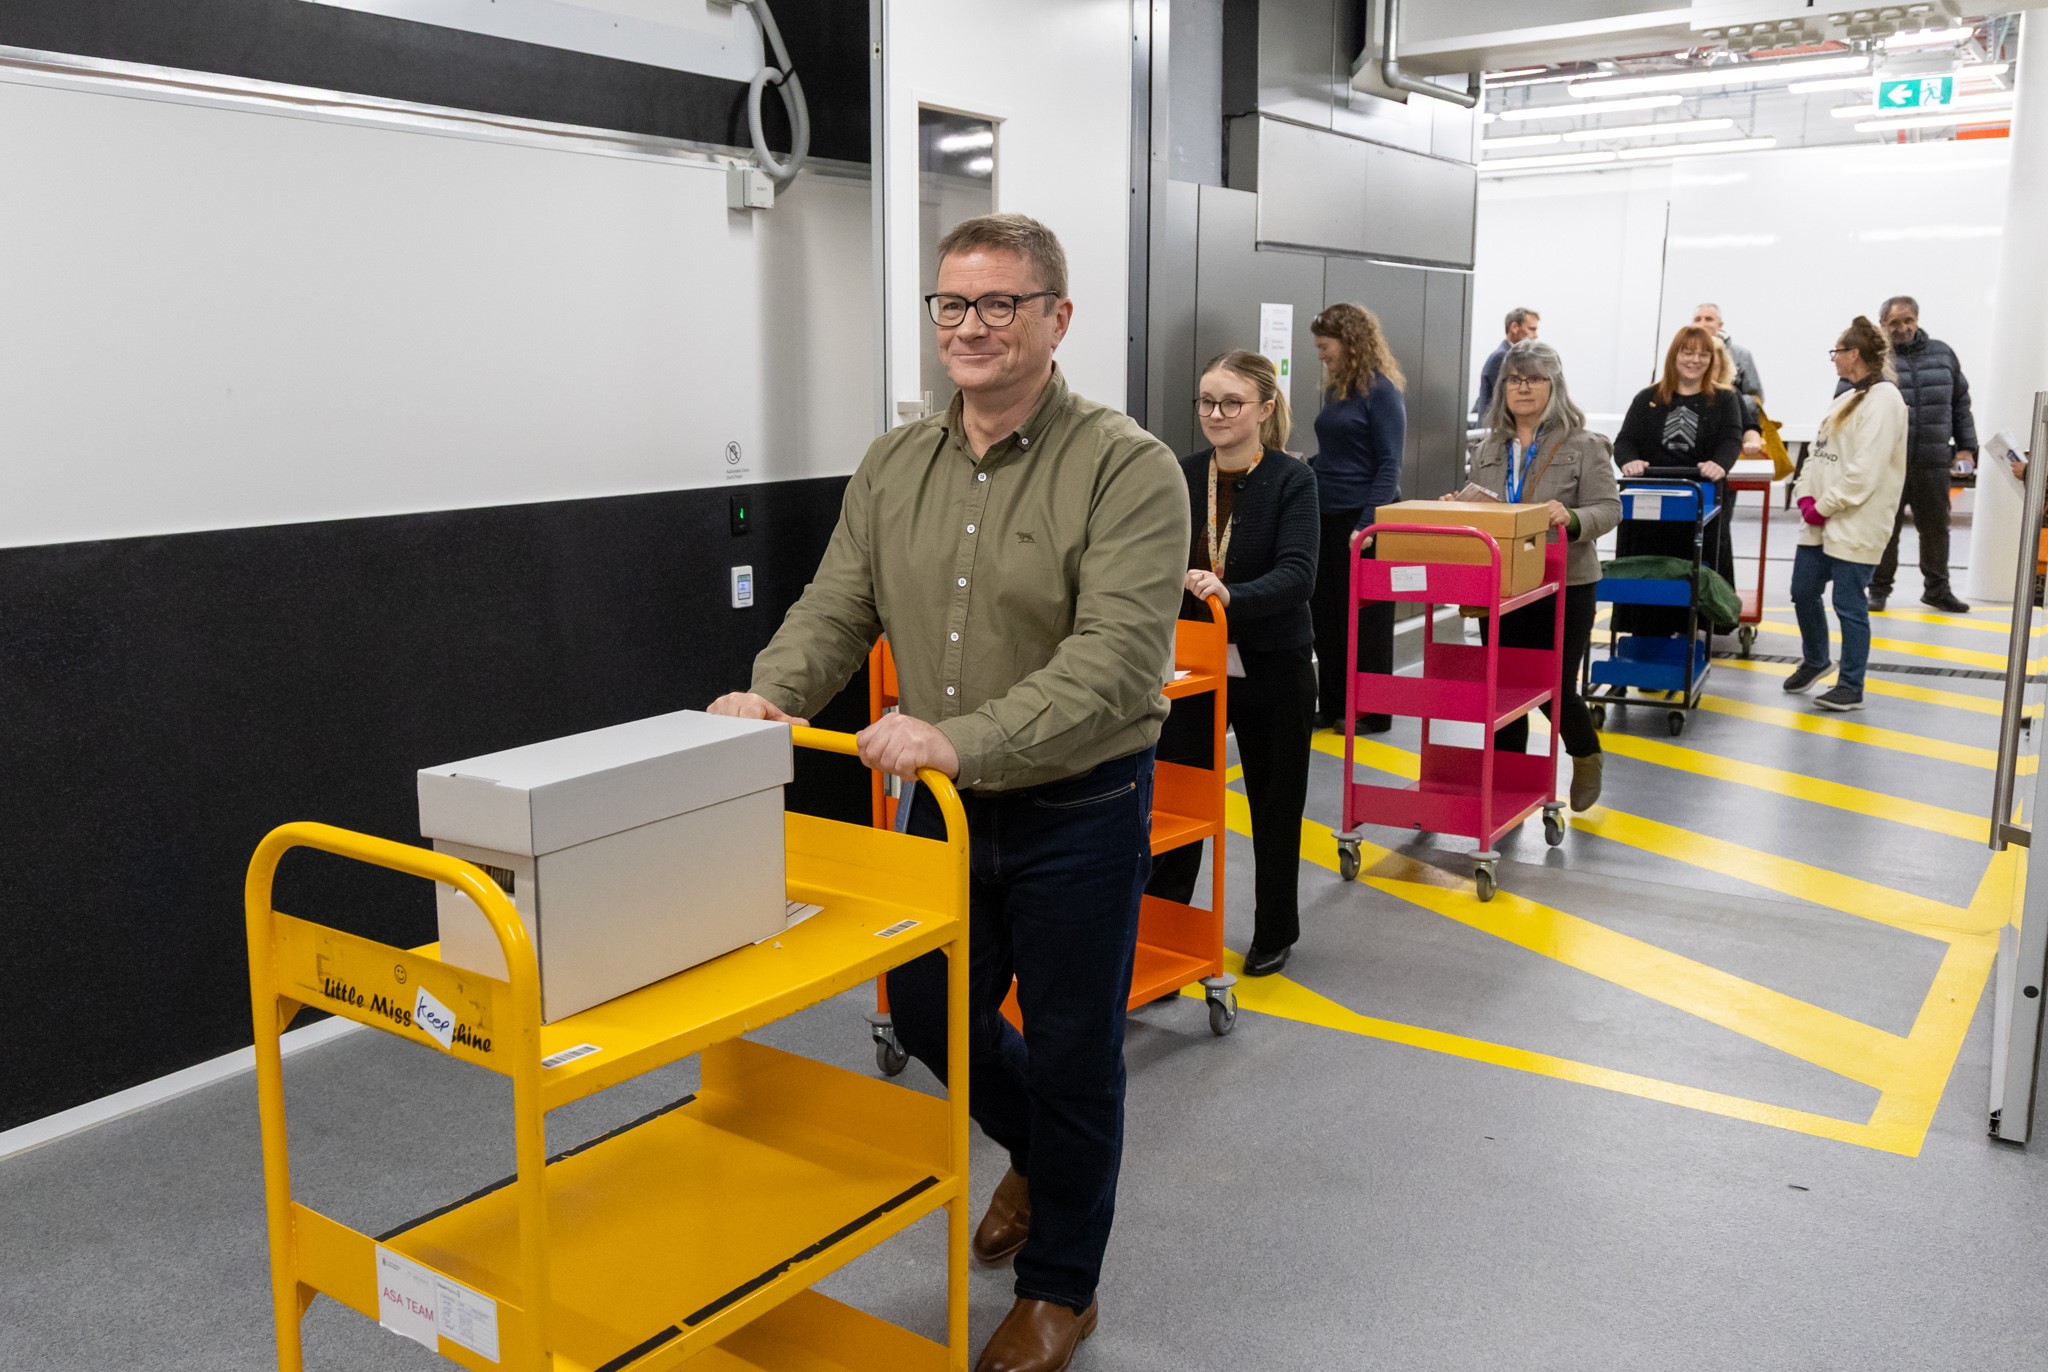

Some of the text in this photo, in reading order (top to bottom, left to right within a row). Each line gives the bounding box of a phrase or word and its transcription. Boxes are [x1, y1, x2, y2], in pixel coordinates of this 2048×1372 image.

[324, 978, 364, 1008] Little
[369, 994, 412, 1027] Miss
[383, 1287, 404, 1307] ASA
[405, 1297, 434, 1322] TEAM
